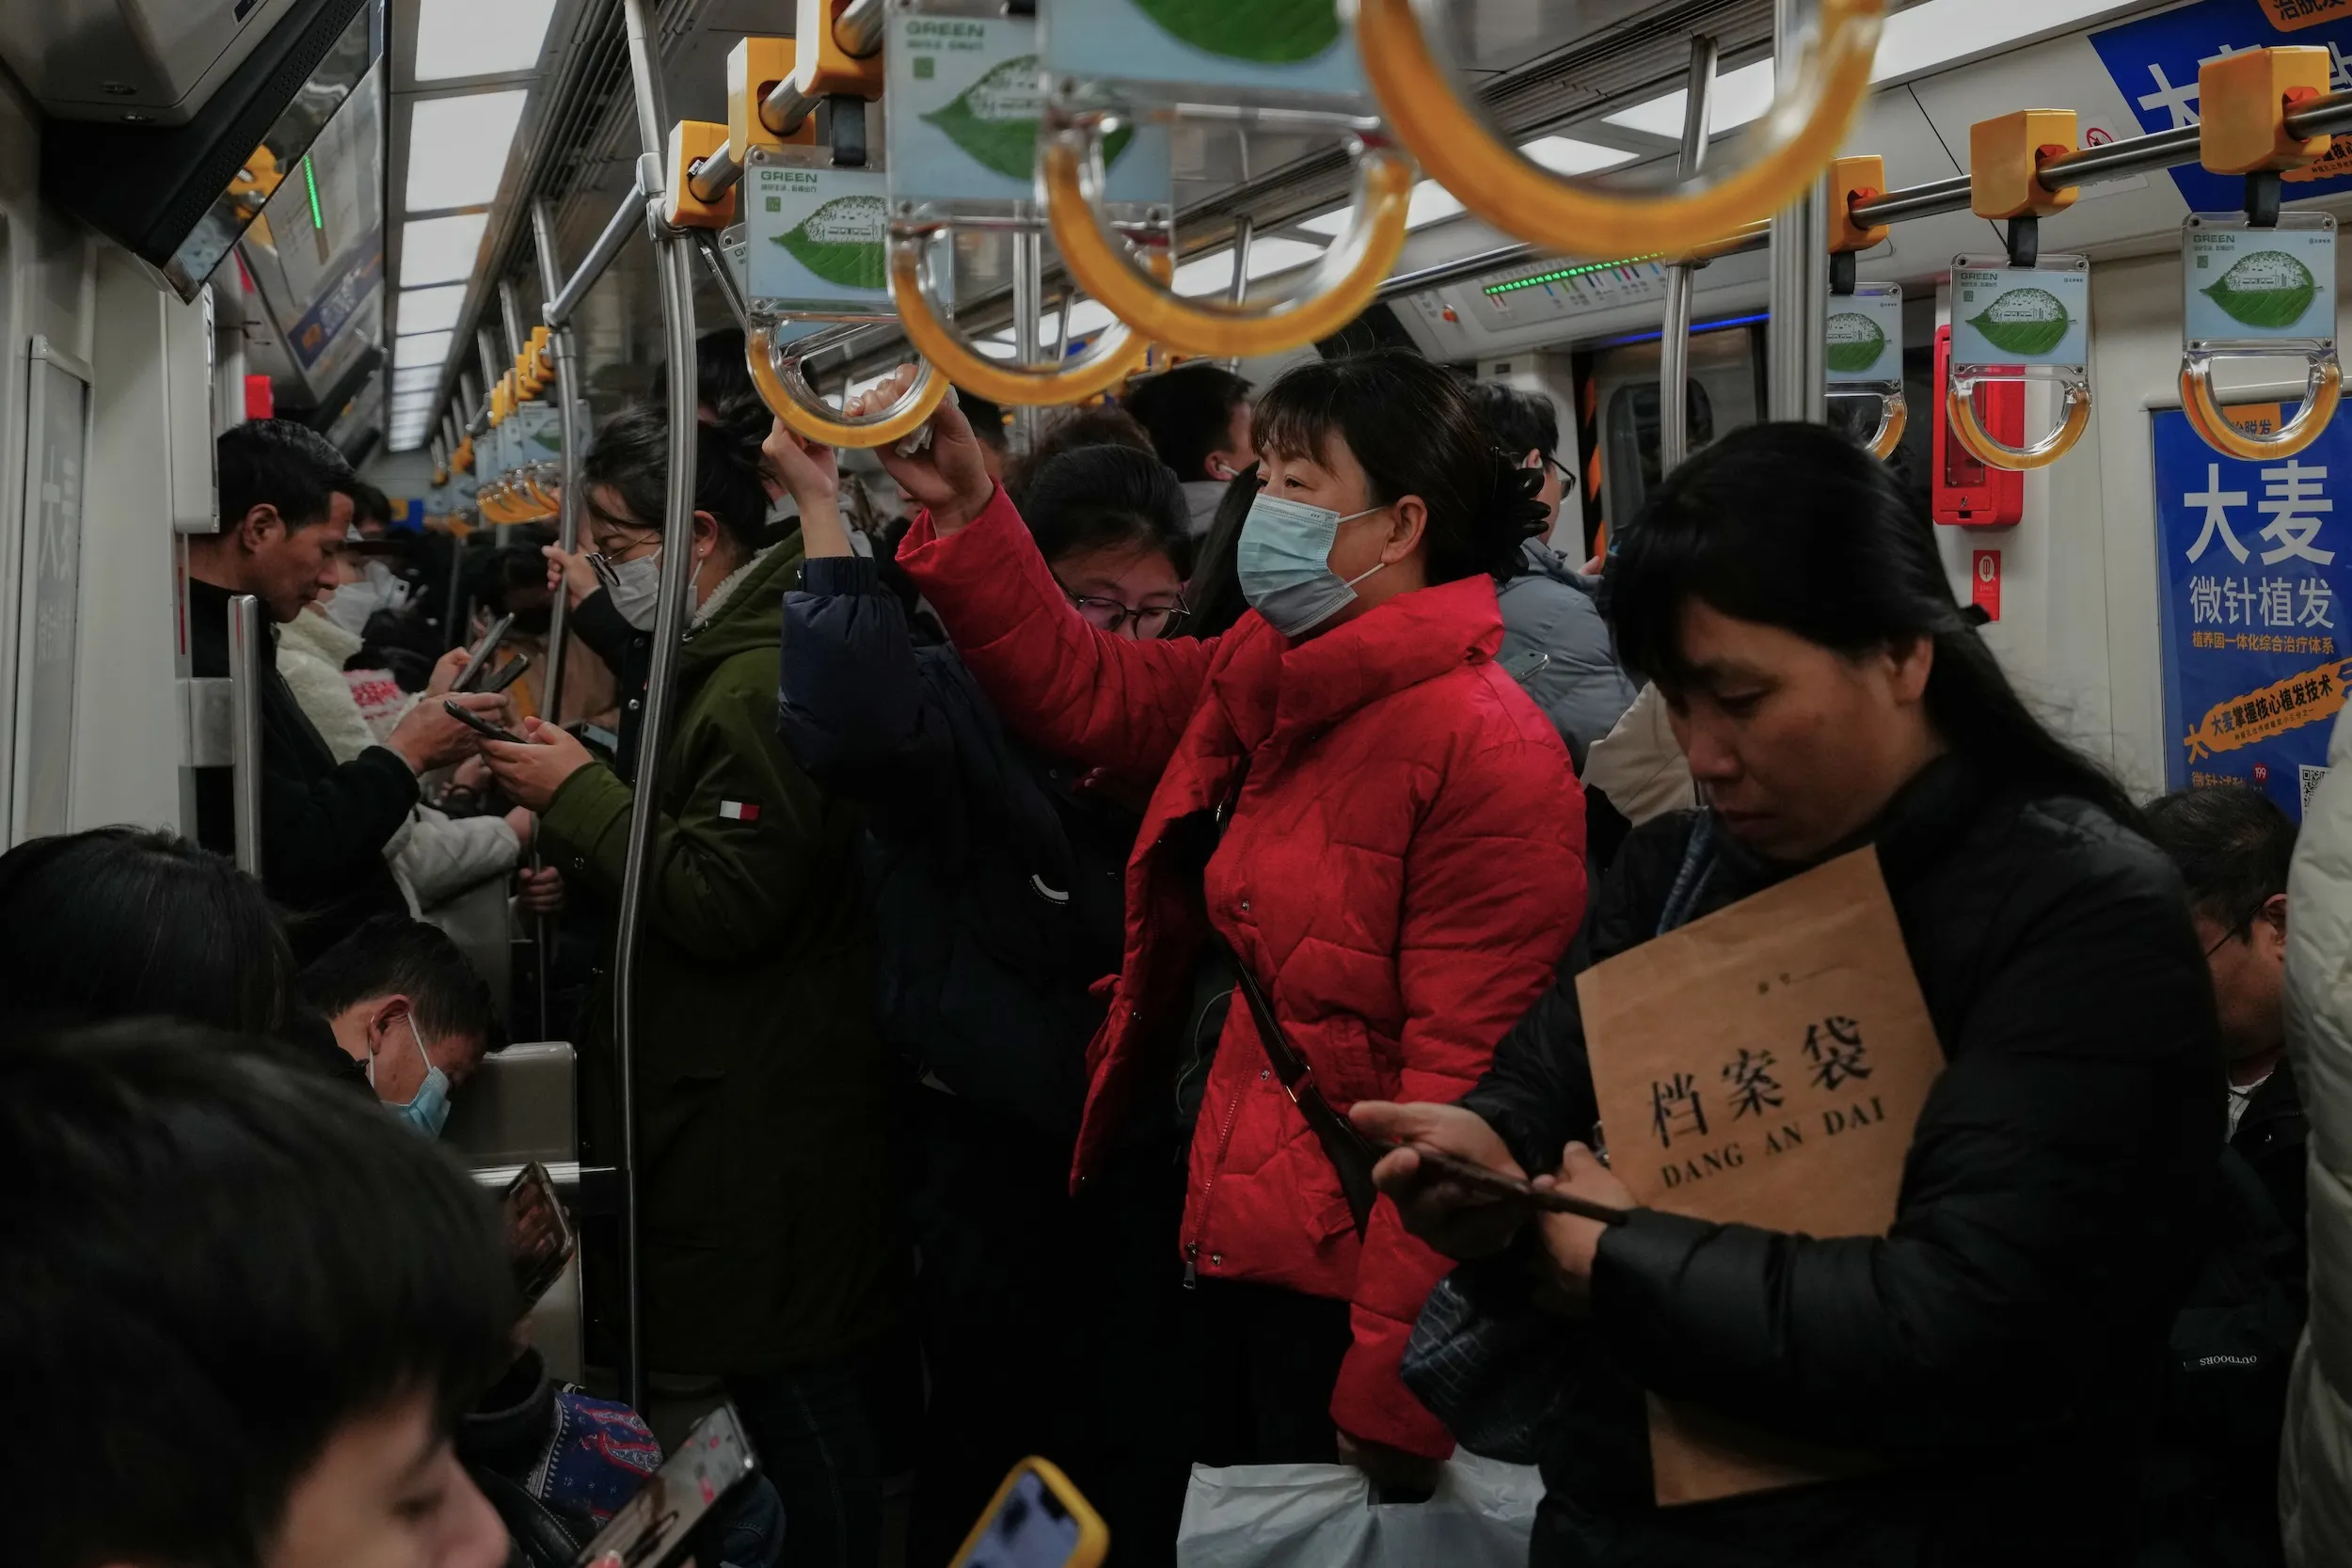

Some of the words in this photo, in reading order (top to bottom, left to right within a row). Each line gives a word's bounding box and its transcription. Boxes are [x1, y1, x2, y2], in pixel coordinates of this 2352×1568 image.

[760, 170, 818, 183] GREEN
[2193, 234, 2235, 243] GREEN
[1961, 272, 1998, 280] GREEN
[2183, 459, 2336, 566] 大麦
[2189, 576, 2335, 629] 微针植发
[2211, 673, 2333, 736] 大麦掌握核心植发技术
[2254, 767, 2267, 780] 199
[1650, 1016, 1873, 1149] 档案袋
[1661, 1142, 1745, 1189] DANG
[1765, 1122, 1804, 1157] AN
[1821, 1096, 1887, 1137] DAI
[2199, 1354, 2258, 1366] OUTDOORS
